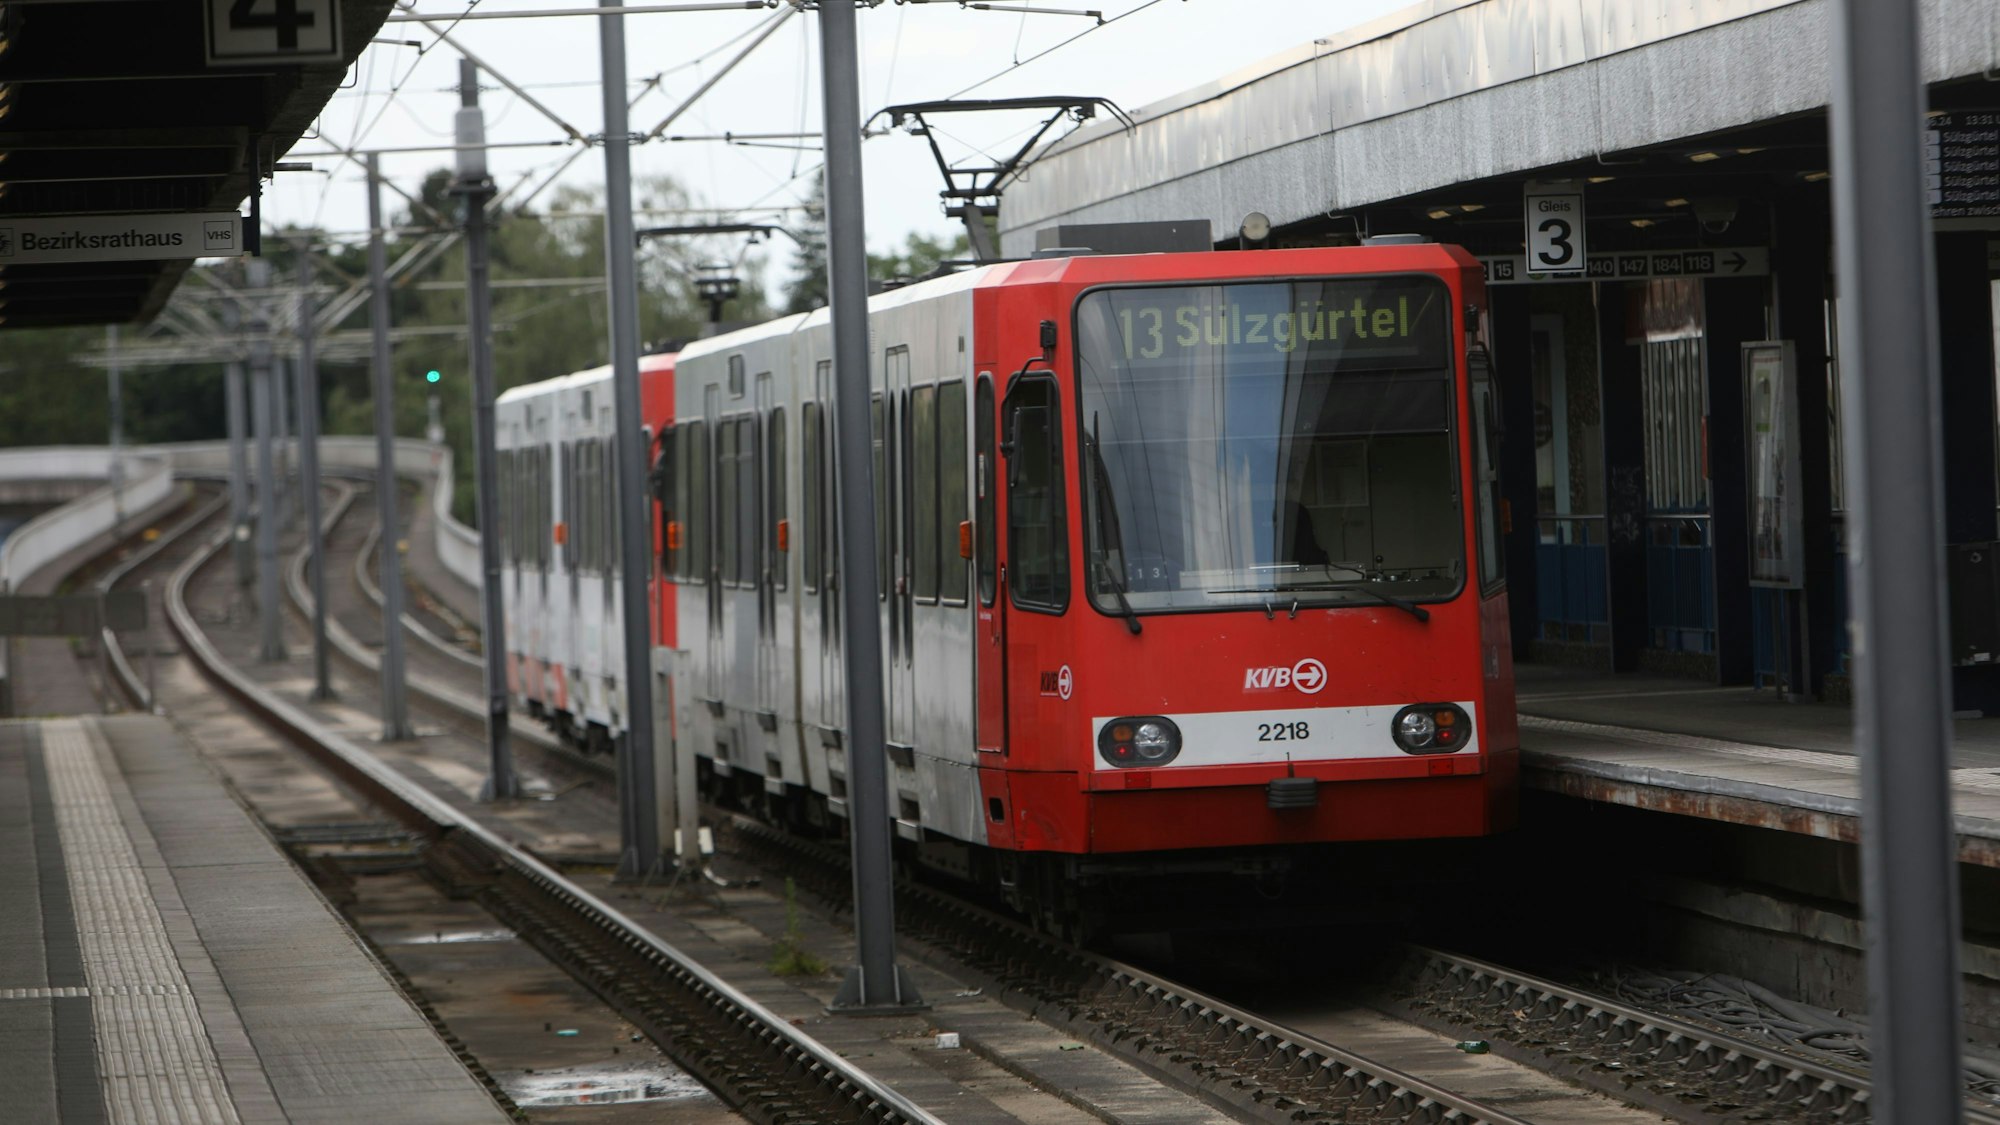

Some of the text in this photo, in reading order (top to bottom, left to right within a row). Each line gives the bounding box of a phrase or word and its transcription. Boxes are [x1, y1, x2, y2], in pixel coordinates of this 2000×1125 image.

[1943, 130, 1998, 144] Sülzgürtel
[1943, 145, 1999, 158] Sülzgürtel
[1943, 160, 1999, 173] Sülzgürtel
[1944, 174, 1999, 188] Sülzgürtel
[1538, 200, 1571, 212] Gleis
[1944, 189, 2000, 203] Sülzgürtel
[21, 229, 231, 250] Bezirksrathaus VHS
[1538, 218, 1573, 266] 3
[1495, 263, 1512, 277] 15
[1587, 261, 1614, 274] 140
[1621, 259, 1645, 273] 147
[1653, 258, 1680, 271] 184
[1685, 255, 1712, 270] 118
[1120, 297, 1408, 359] 13 Sülzgürtel
[1040, 671, 1059, 691] KVB
[1244, 667, 1291, 689] KVB
[1258, 721, 1309, 741] 2218
